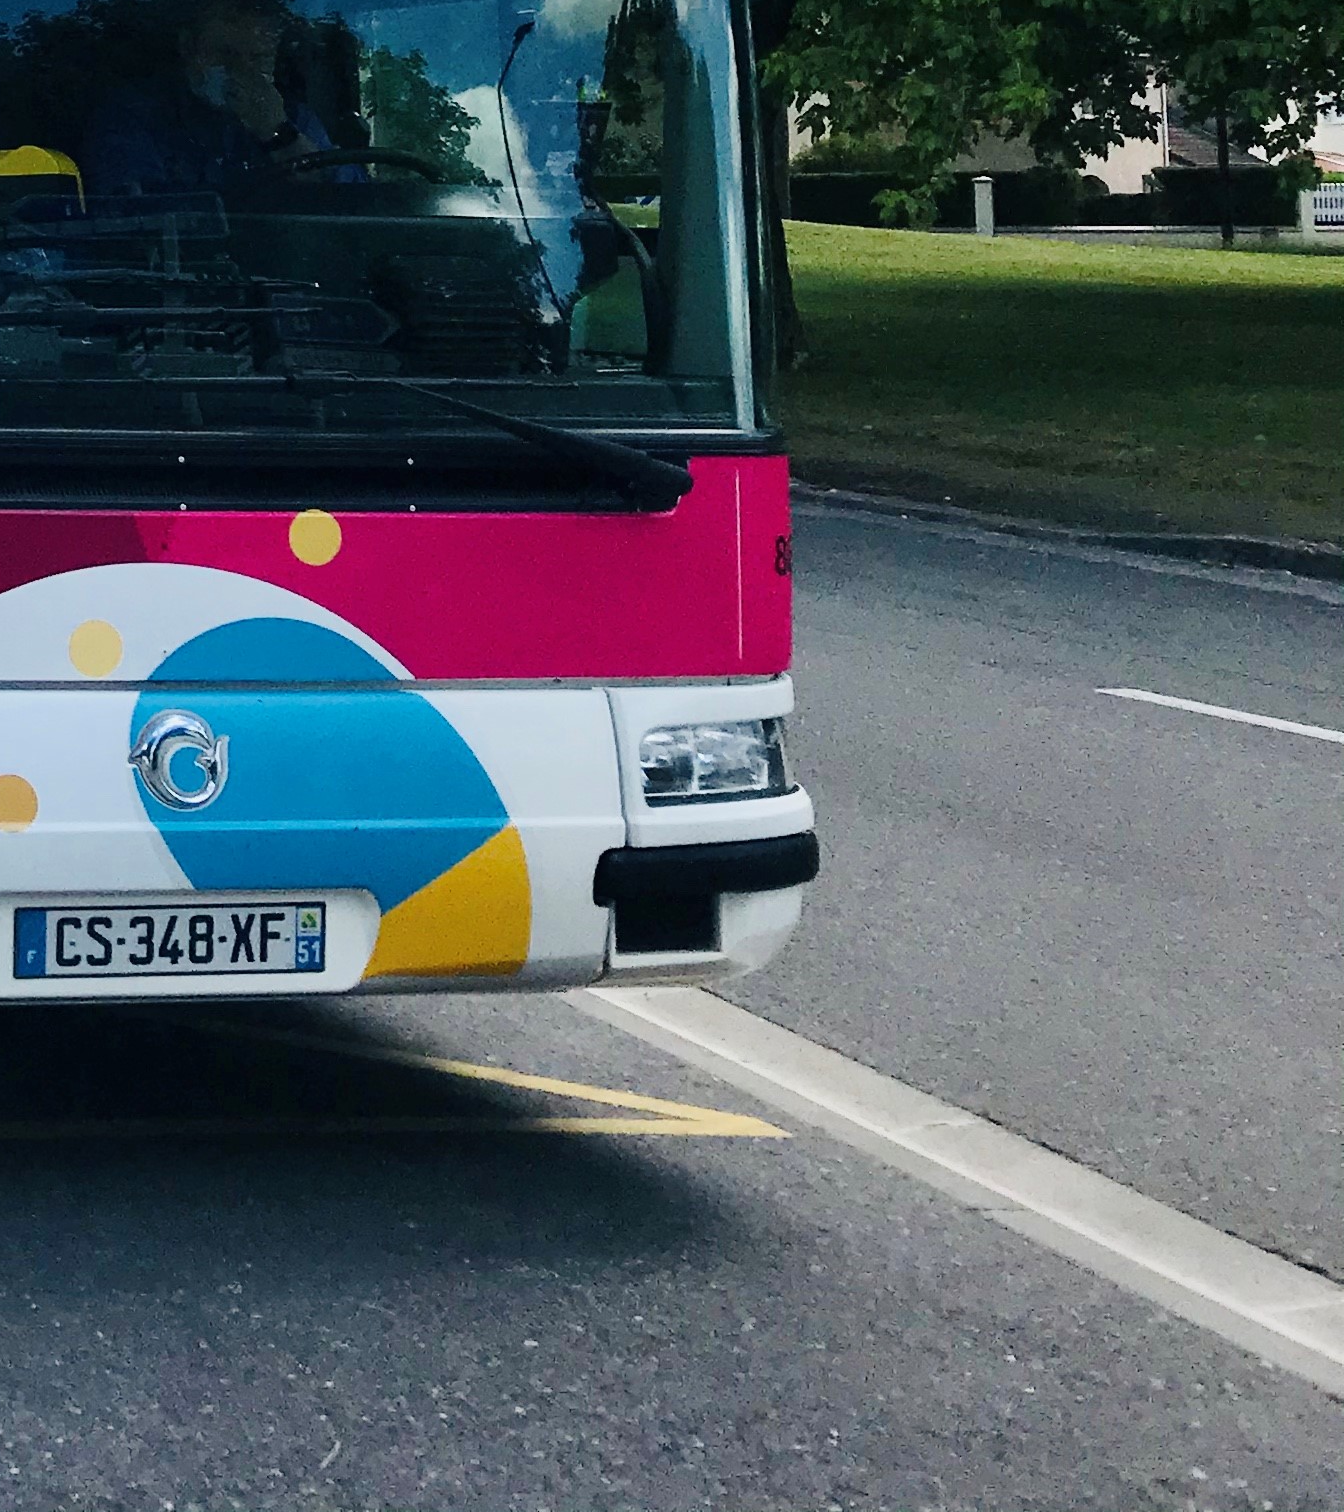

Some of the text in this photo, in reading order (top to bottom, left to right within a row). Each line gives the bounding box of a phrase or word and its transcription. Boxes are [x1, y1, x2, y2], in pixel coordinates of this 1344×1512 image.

[55, 912, 287, 966] CS-348-XF
[27, 950, 37, 964] F
[297, 941, 321, 964] 51
